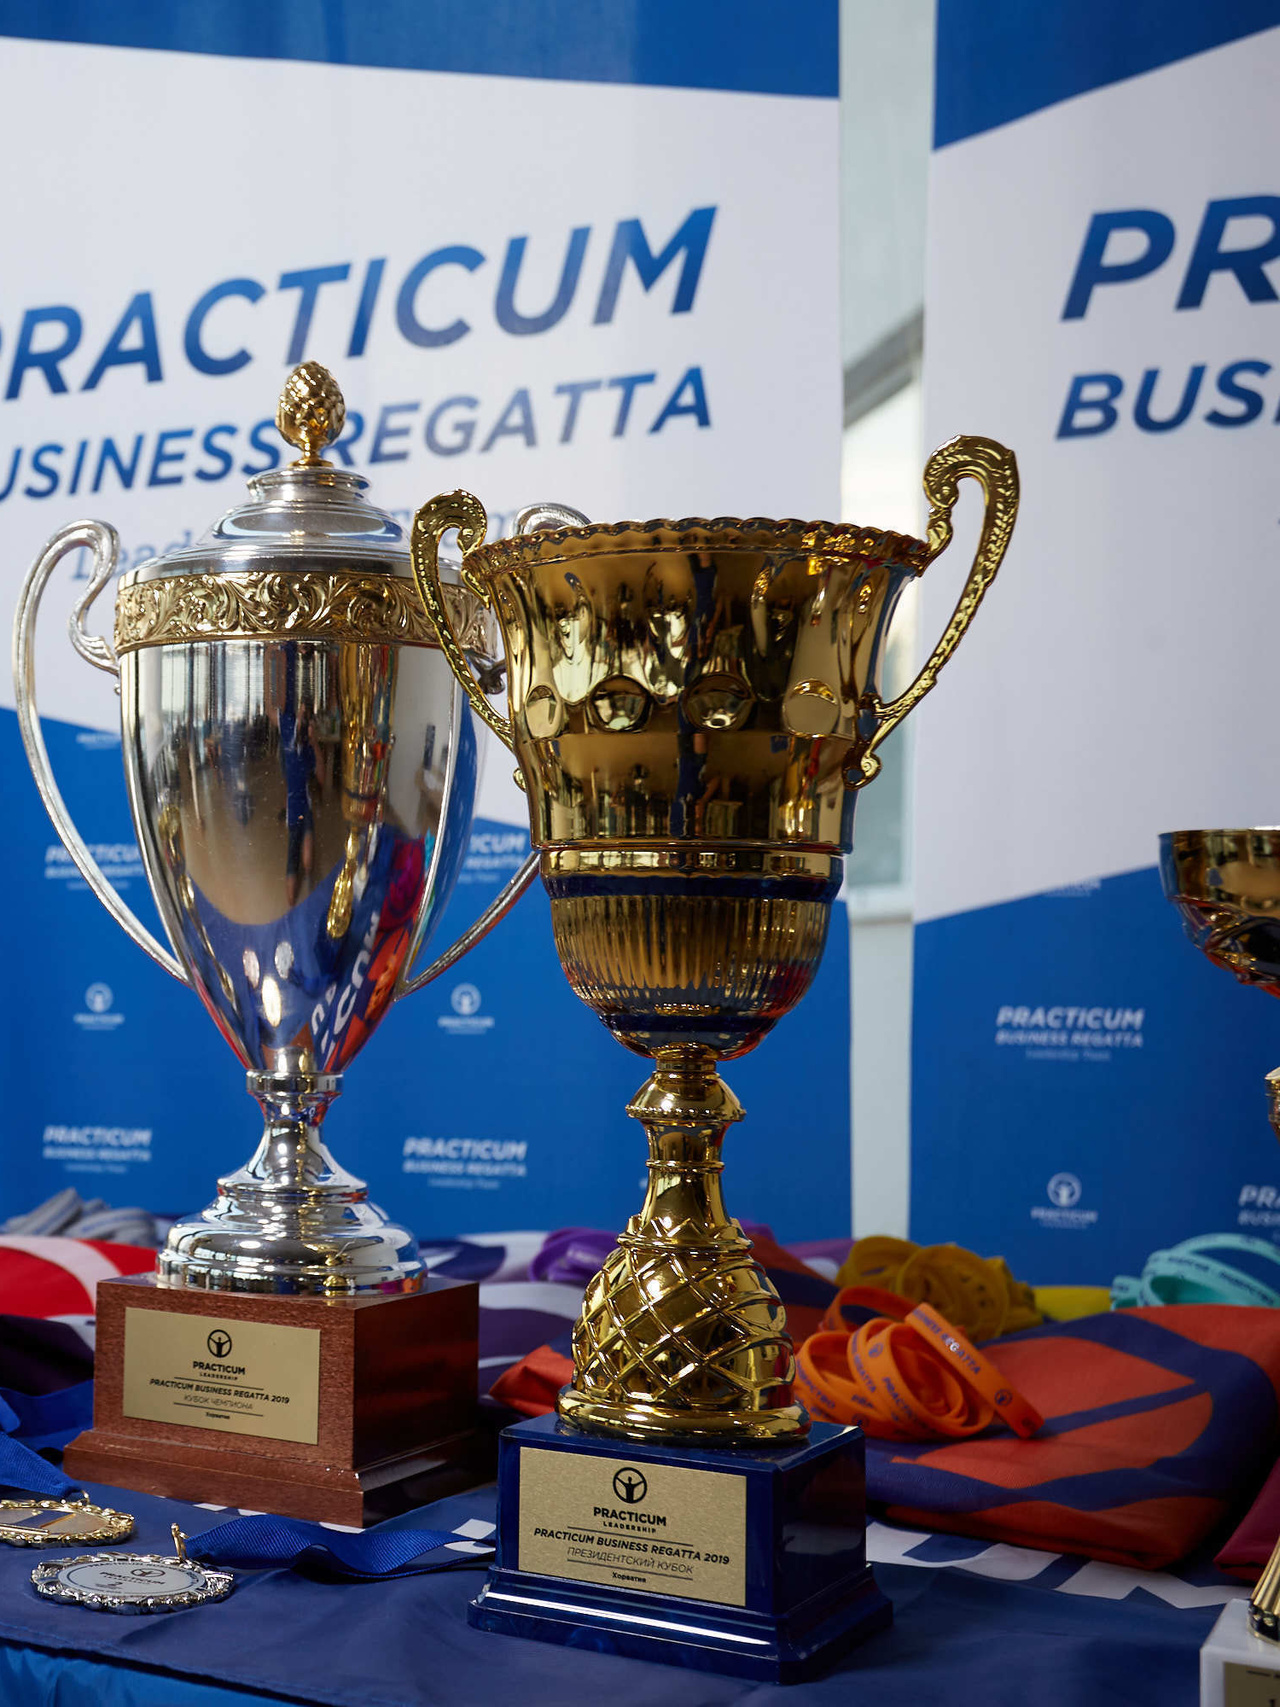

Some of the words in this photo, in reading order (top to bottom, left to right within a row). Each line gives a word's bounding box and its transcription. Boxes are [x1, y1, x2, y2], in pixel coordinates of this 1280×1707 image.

[1054, 359, 1280, 440] BUS
[996, 1006, 1145, 1030] PRACTICUM
[43, 1125, 153, 1147] PRACTICUM
[403, 1137, 528, 1160] PRACTICUM
[192, 1361, 245, 1375] PRACTICUM
[200, 1372, 238, 1381] LEADERSHIP
[149, 1378, 194, 1391] PRACTICUM
[195, 1384, 232, 1397] BUSINESS
[234, 1390, 270, 1402] REGATTA
[271, 1394, 290, 1404] 2019
[593, 1506, 667, 1527] PRACTICUM
[603, 1521, 656, 1534] LEADERSHIP
[534, 1527, 595, 1545] PRACTICUM
[596, 1536, 649, 1553] BUSINESS
[651, 1545, 702, 1561] REGATTA
[704, 1553, 730, 1565] 2019
[566, 1547, 656, 1569] ПРЕЗИДЕНТСКИЙ
[657, 1560, 694, 1574] КУБОК
[612, 1572, 646, 1583] Хорватия
